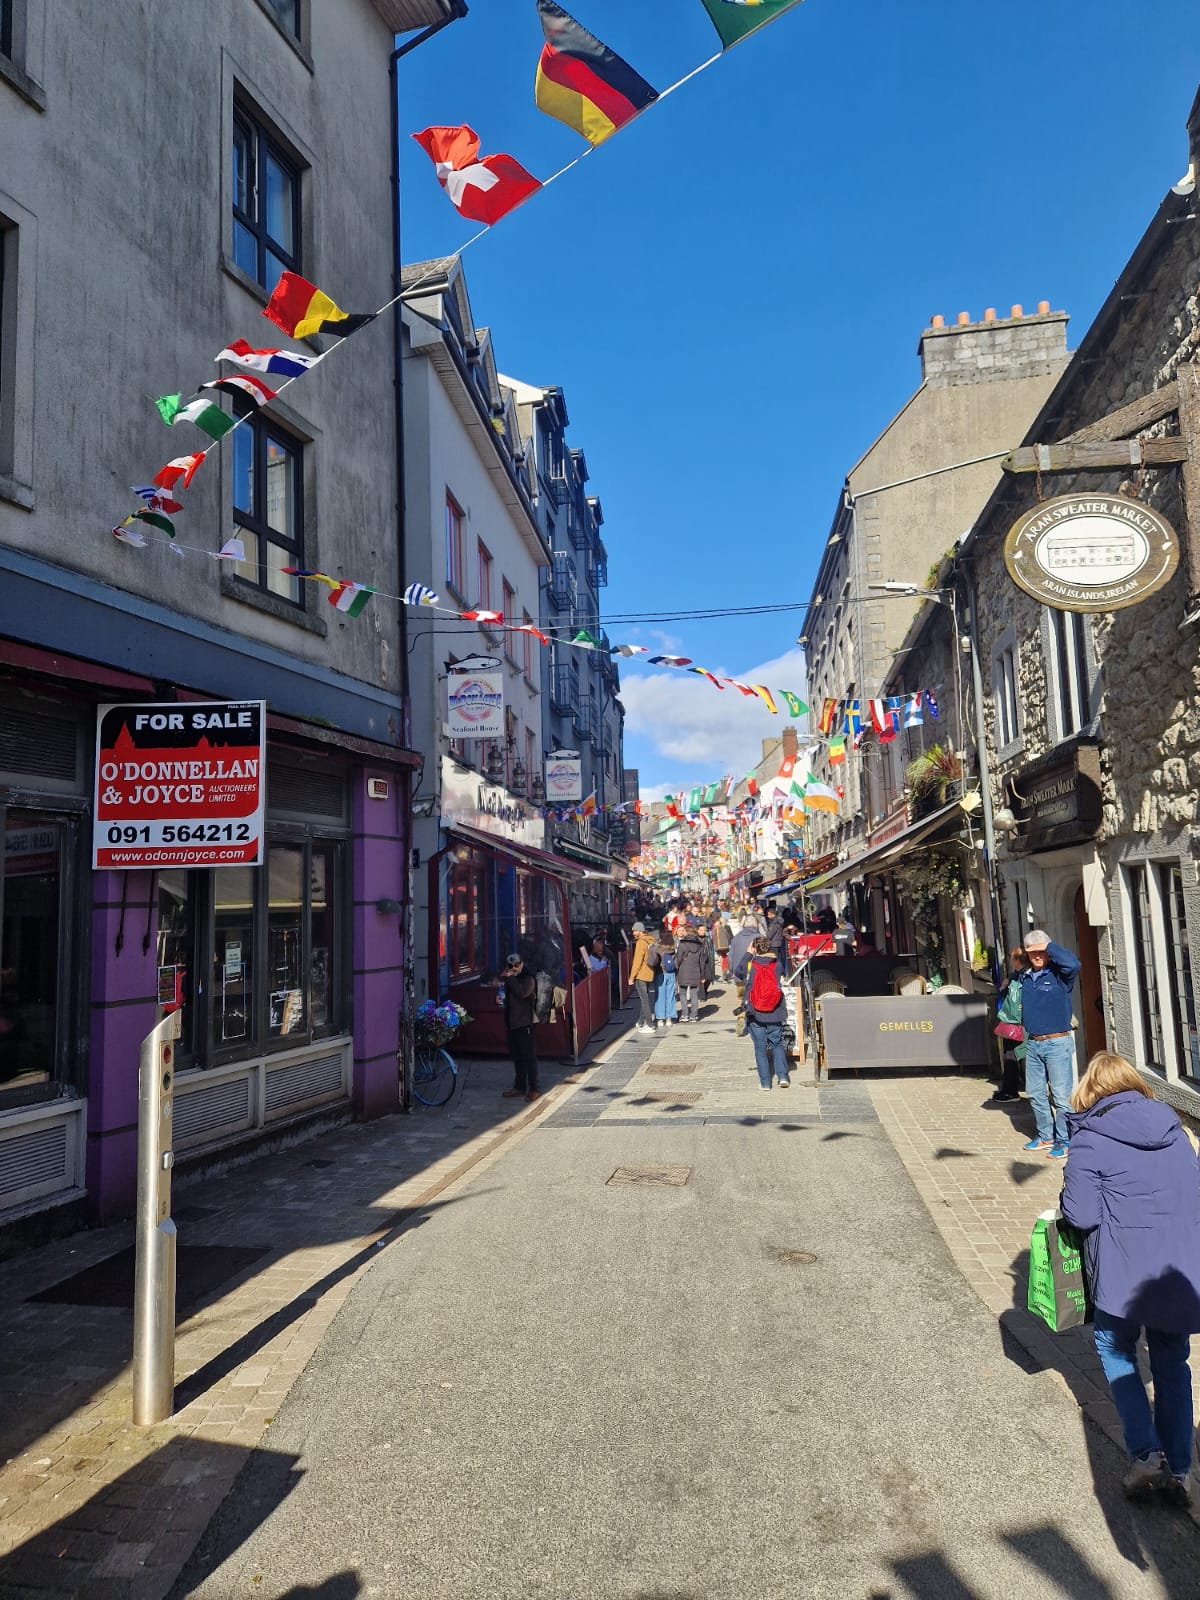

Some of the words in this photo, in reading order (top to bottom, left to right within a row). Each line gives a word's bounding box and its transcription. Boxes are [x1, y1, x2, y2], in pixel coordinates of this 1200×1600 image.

[1024, 515, 1055, 542] ARAN
[1053, 503, 1109, 520] SWEATER
[1111, 505, 1157, 534] MARKET
[1042, 580, 1067, 595] ARAN
[135, 714, 184, 730] FOR
[191, 712, 252, 729] SALE
[101, 759, 259, 781] O'DONNELLAN
[101, 786, 123, 804] &
[128, 785, 205, 804] JOYCE
[208, 784, 256, 793] AUCTIONEERS
[208, 793, 236, 802] LIMITED
[107, 826, 150, 843] 091
[162, 823, 250, 842] 564212
[111, 850, 245, 862] www.odonnjoyce.com
